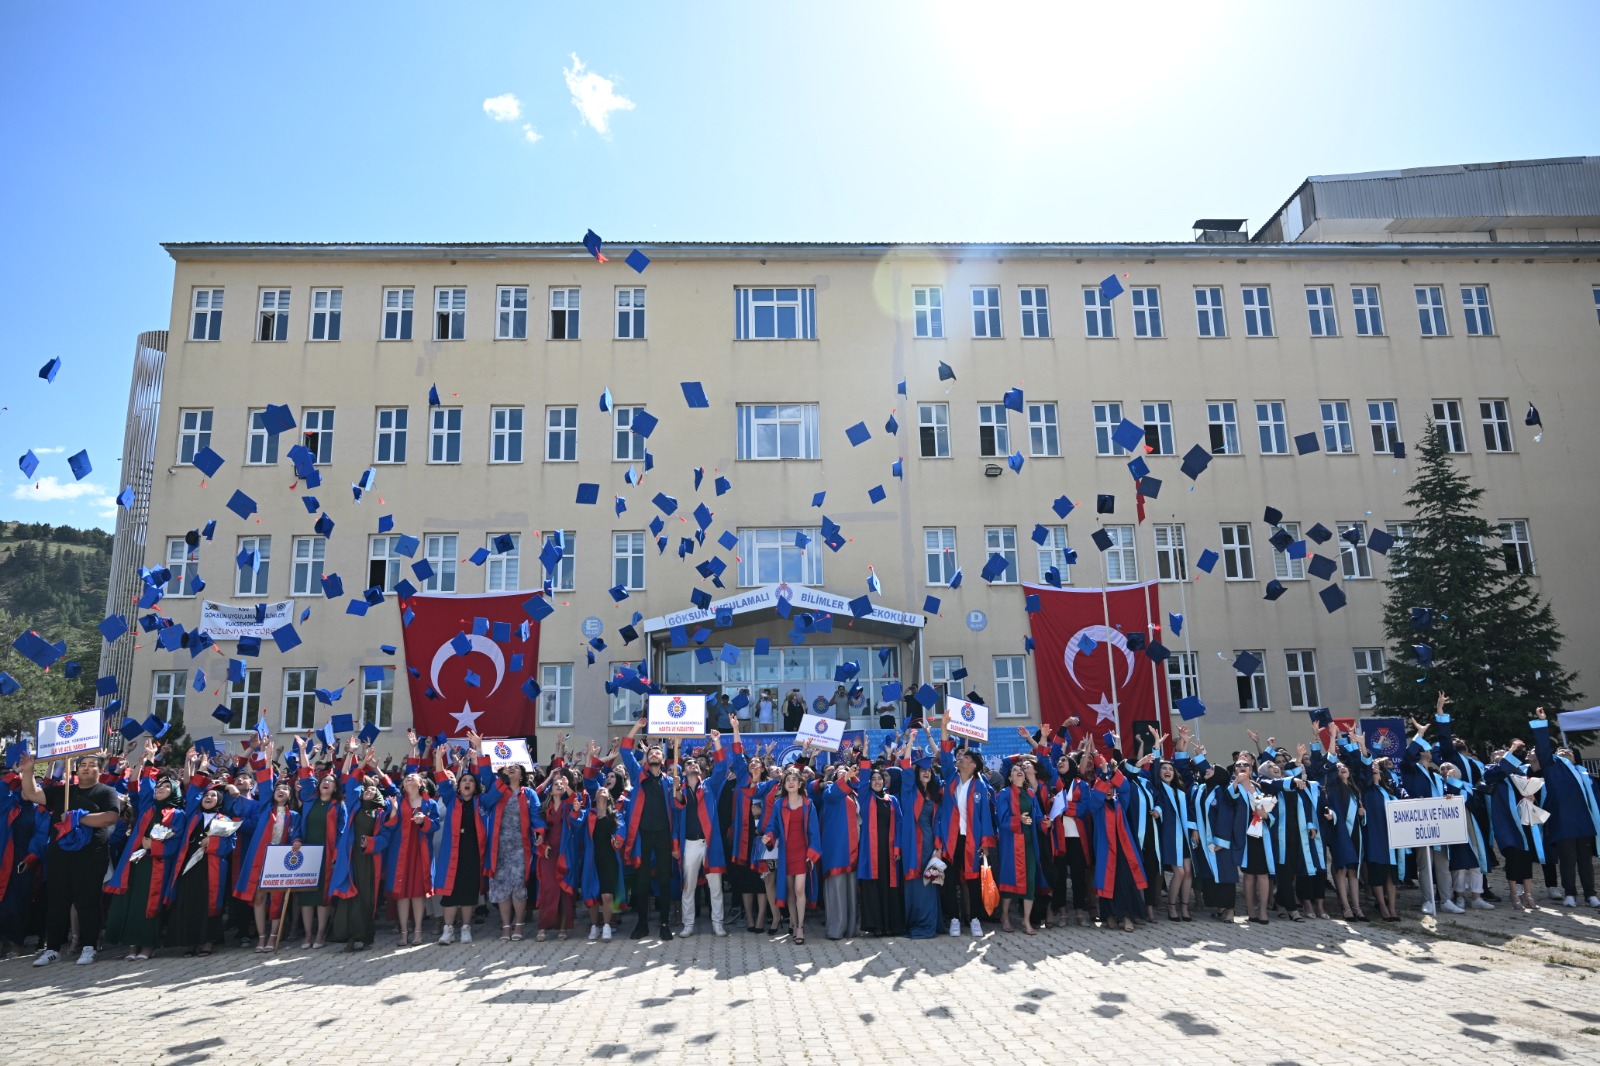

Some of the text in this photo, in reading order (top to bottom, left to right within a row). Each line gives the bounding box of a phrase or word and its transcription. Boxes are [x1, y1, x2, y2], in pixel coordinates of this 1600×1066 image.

[668, 608, 708, 626] GÖKSUN
[801, 592, 844, 610] BİLİMLER
[970, 612, 983, 622] D
[586, 619, 599, 630] E
[1394, 805, 1460, 823] BANKACILIK VE FİNANS
[1416, 823, 1440, 839] BÖLÜMÜ
